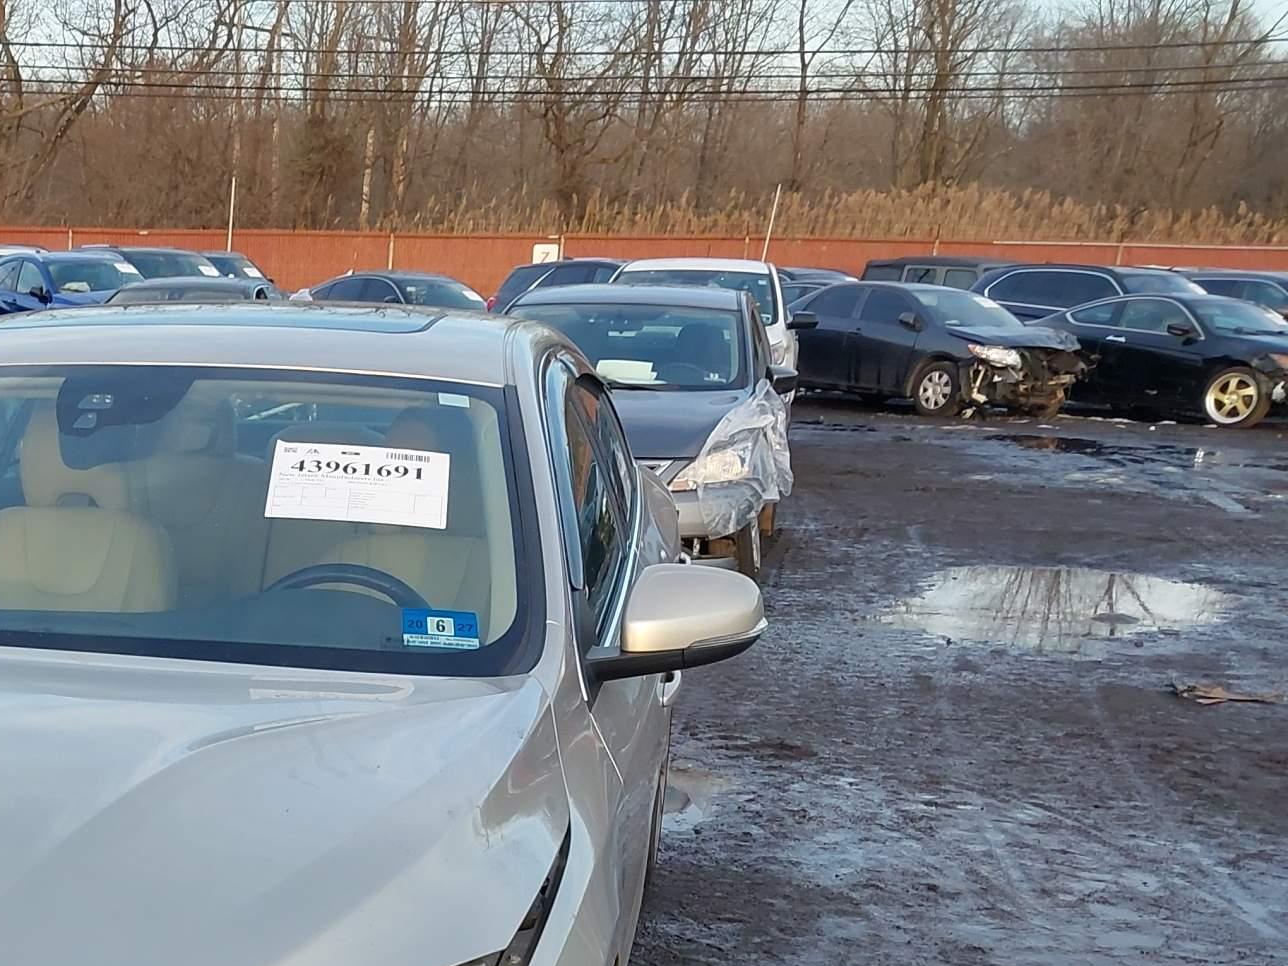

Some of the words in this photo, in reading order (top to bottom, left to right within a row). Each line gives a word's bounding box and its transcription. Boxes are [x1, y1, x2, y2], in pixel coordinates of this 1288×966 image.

[290, 459, 425, 481] 43961691
[407, 619, 424, 629] 20
[435, 619, 446, 633] 6
[457, 623, 474, 632] 27
